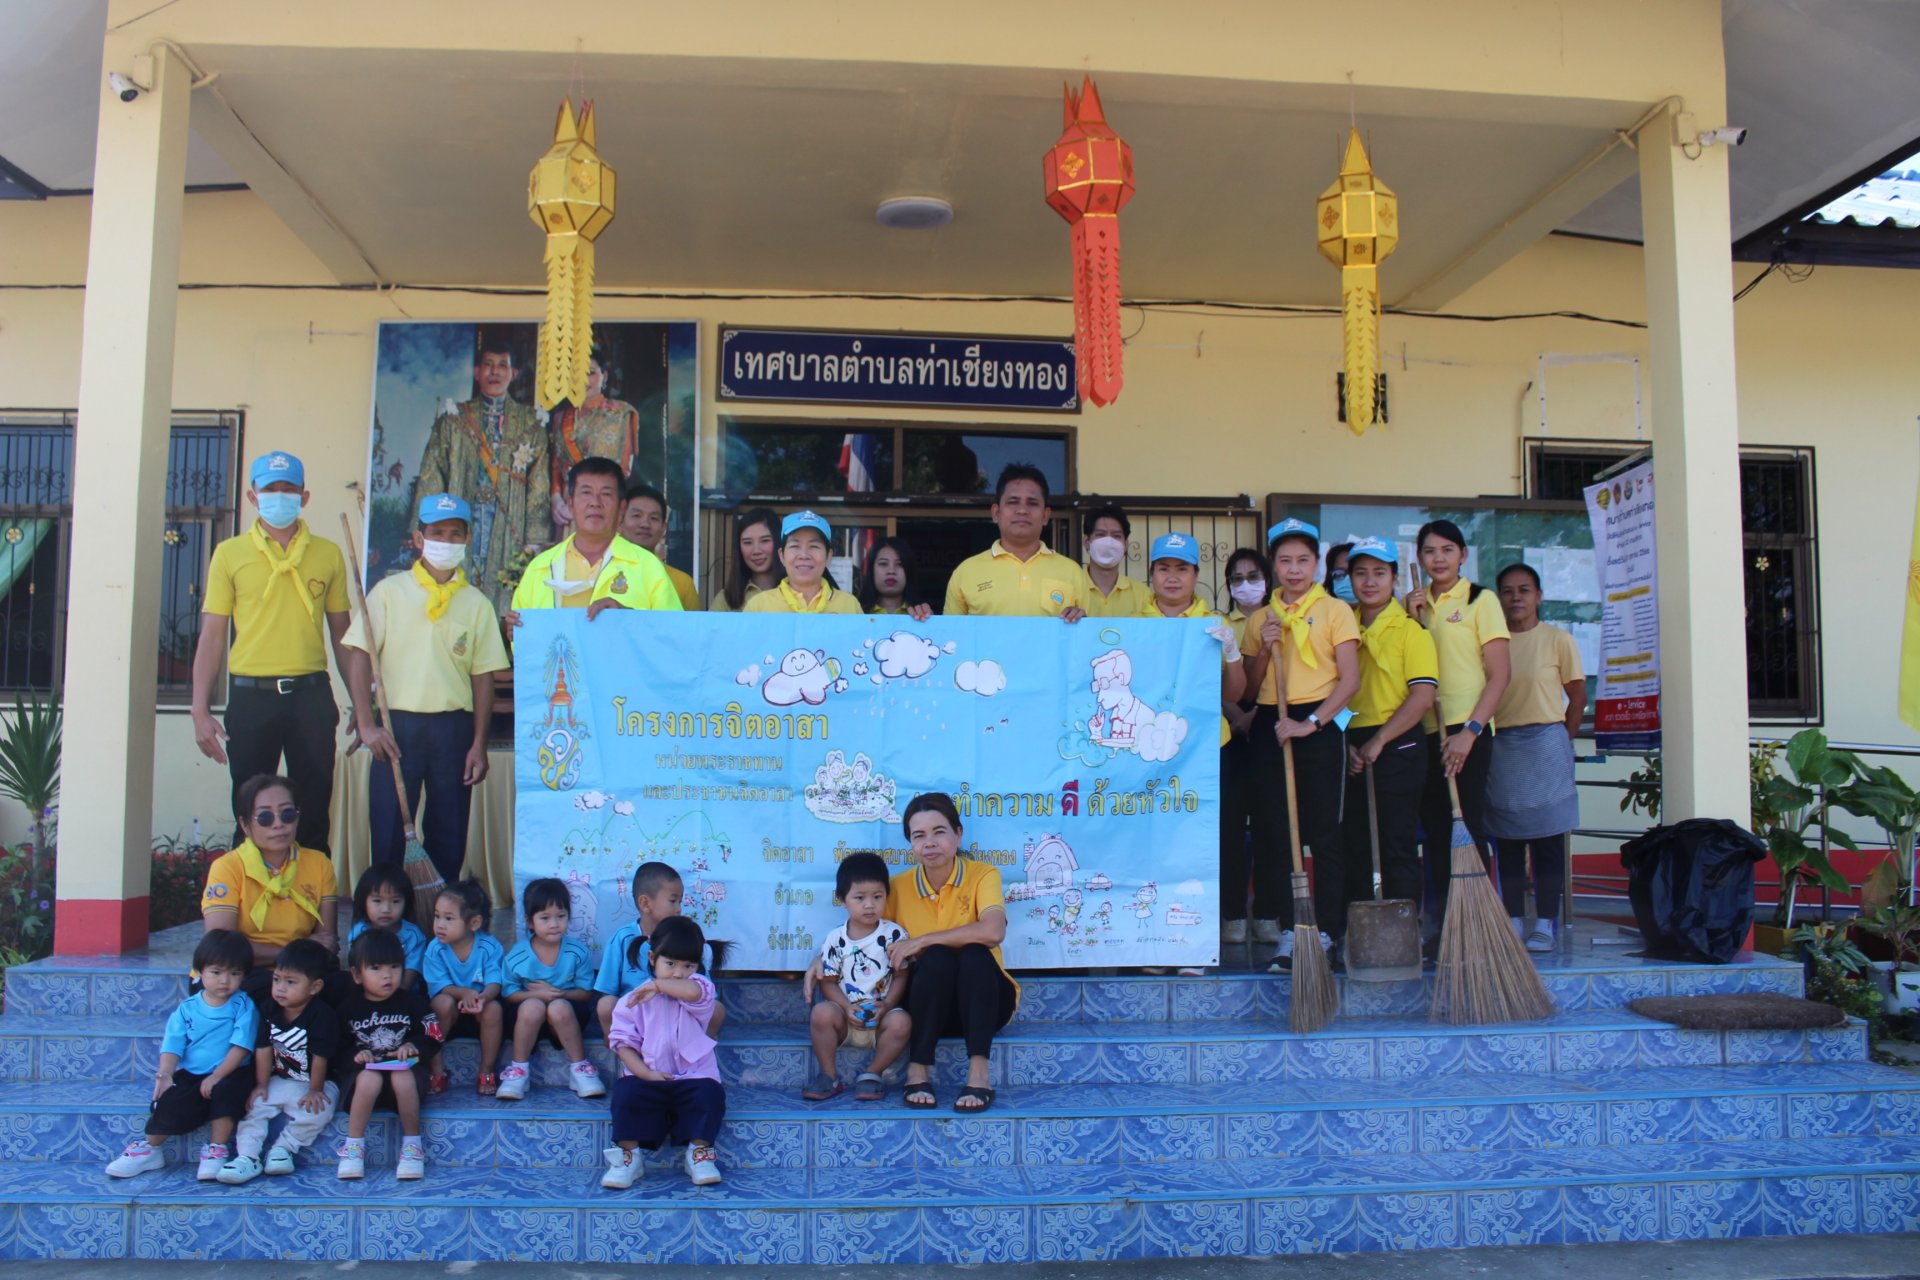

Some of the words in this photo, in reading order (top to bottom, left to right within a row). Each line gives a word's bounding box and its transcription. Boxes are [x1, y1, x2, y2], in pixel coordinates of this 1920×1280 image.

[734, 341, 1068, 391] เทศบาลตำบลท่าเชียงทอง
[612, 696, 829, 740] โครงการจิตอาสา
[655, 745, 783, 771] หน่วยพระราชทาน
[643, 778, 794, 801] และประชาชนจิตอาสา
[1061, 780, 1080, 817] ดี
[1088, 776, 1199, 816] ด้วยหัวใจ
[762, 839, 815, 863] จิตอาสา
[774, 883, 814, 906] อำเภอ
[767, 926, 813, 950] จังหวัด
